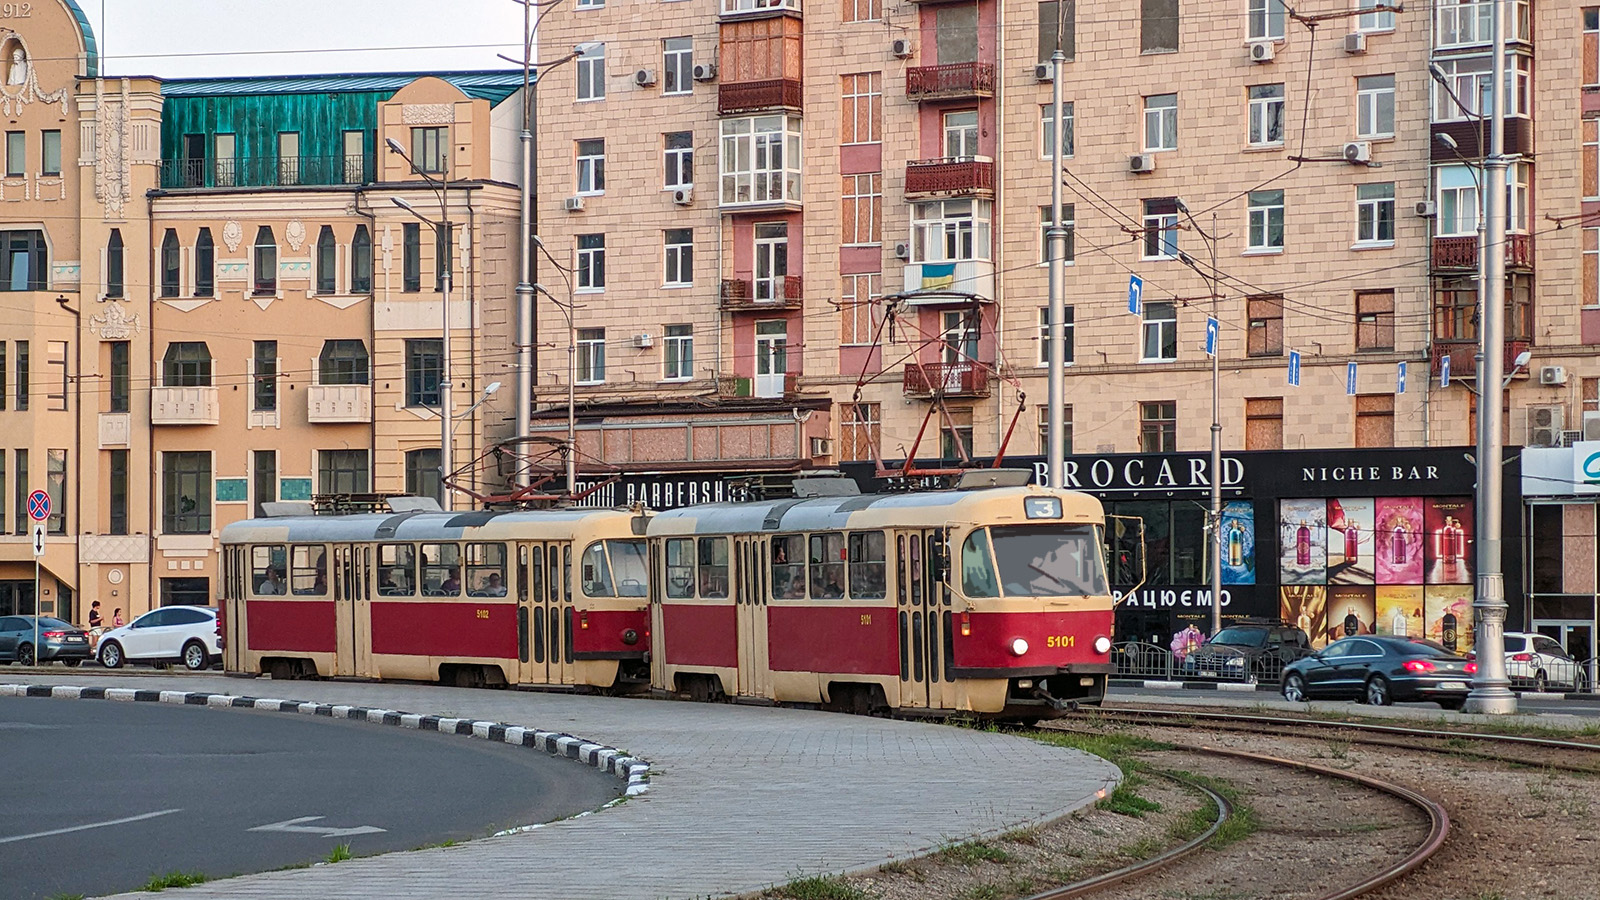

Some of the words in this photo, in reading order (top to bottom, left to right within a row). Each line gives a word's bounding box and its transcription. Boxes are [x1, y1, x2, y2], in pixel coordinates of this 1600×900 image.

[0, 2, 31, 18] 912
[1033, 458, 1245, 488] BROCARD
[1302, 466, 1381, 481] NICHE
[1391, 465, 1440, 480] BAR
[1034, 500, 1055, 518] 3
[476, 609, 489, 619] 5102
[1047, 635, 1075, 648] 5101
